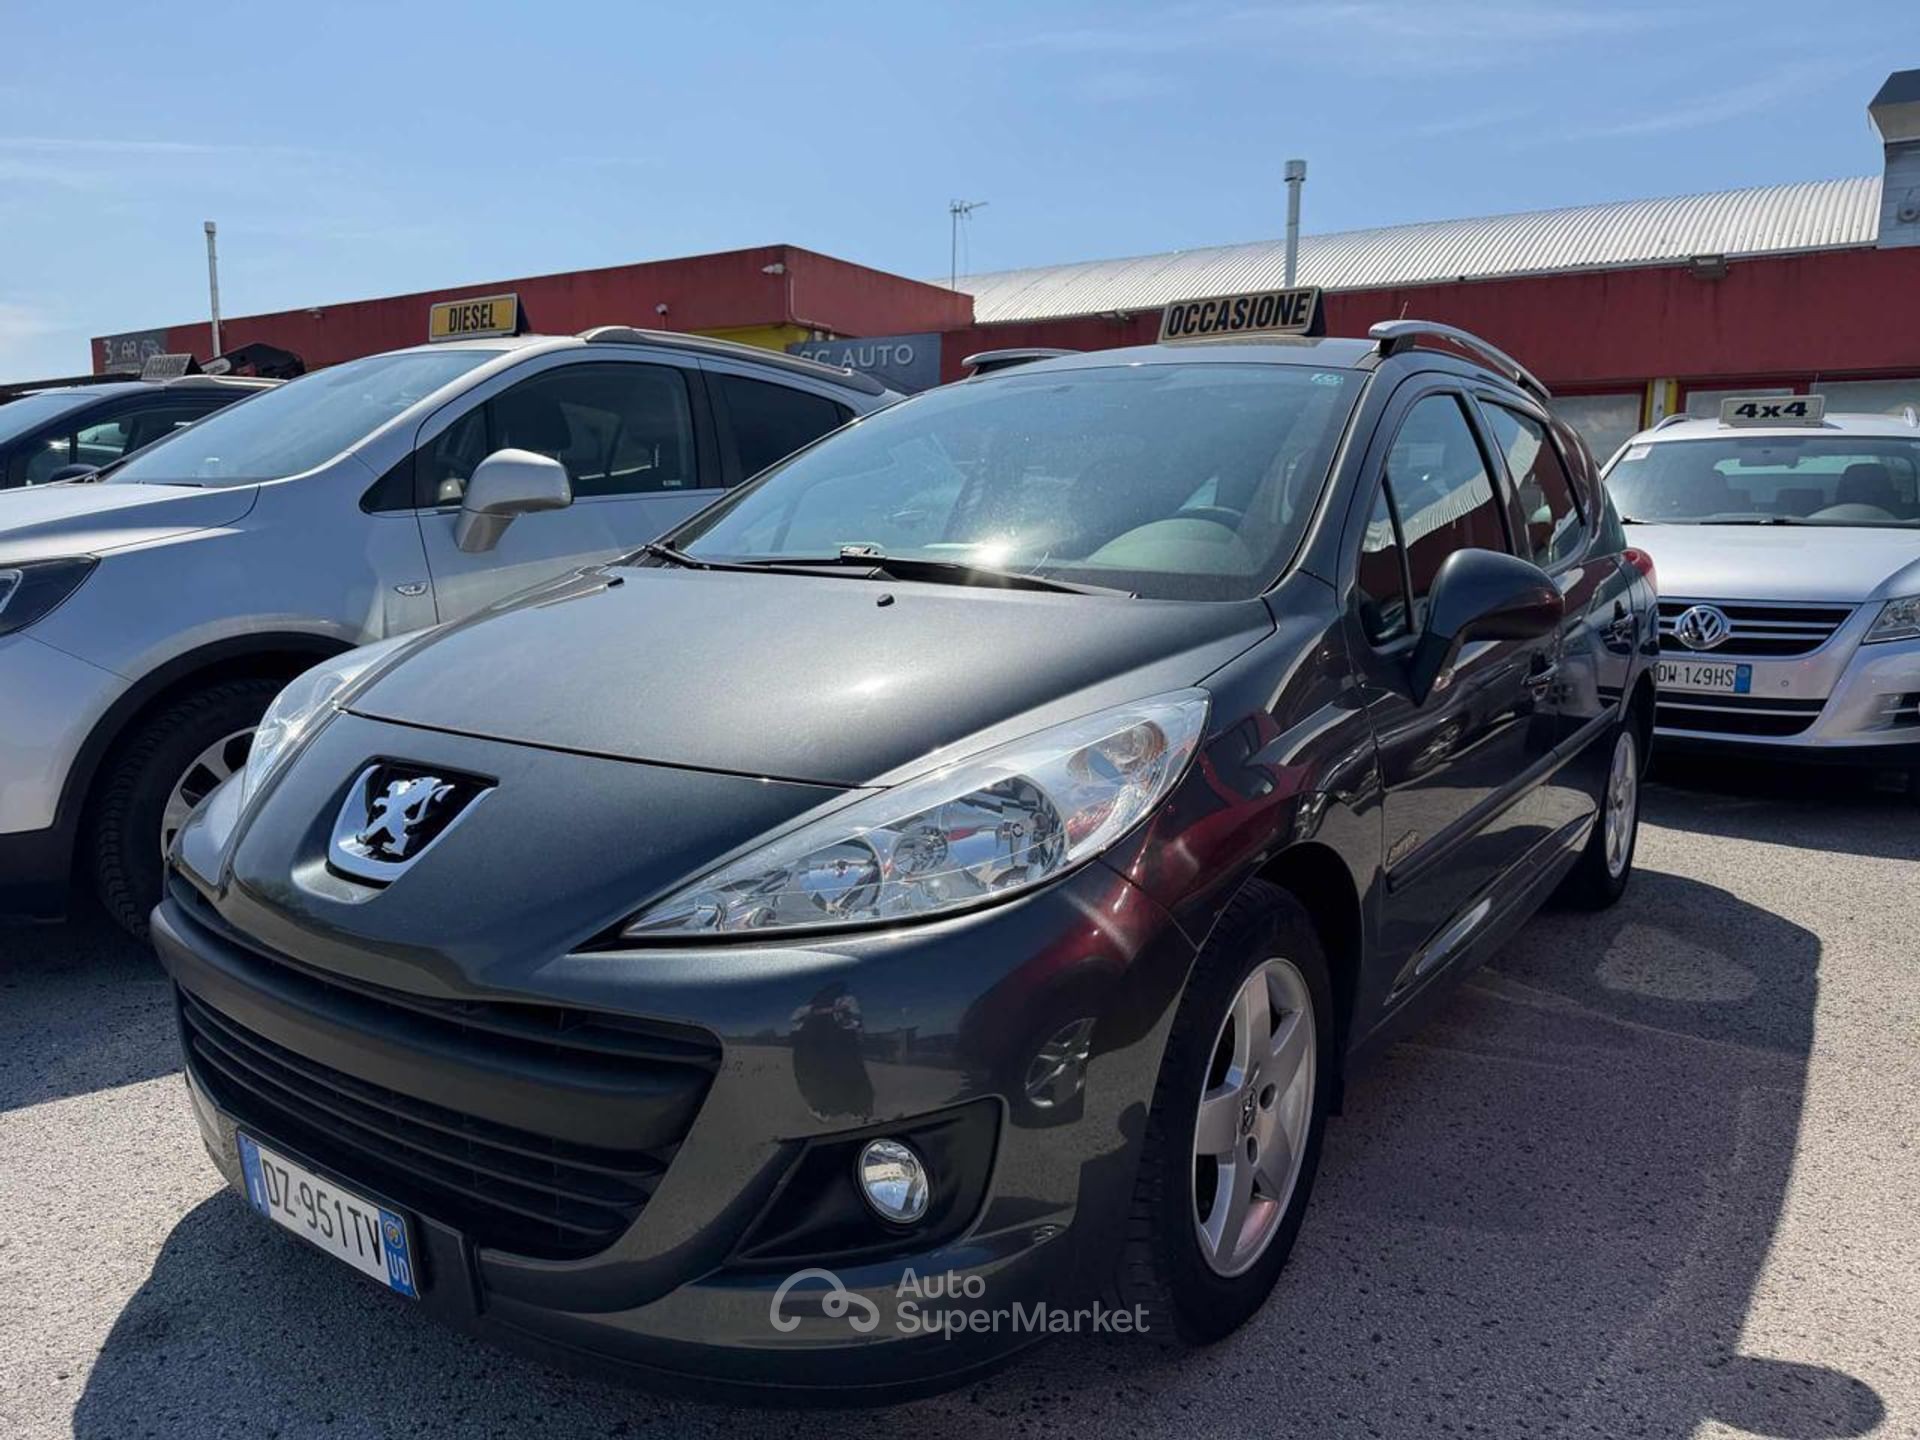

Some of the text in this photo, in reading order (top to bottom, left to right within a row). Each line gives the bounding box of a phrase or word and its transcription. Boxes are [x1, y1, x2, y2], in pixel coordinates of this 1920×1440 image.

[448, 303, 496, 332] DIESEL
[1166, 292, 1311, 336] OCCASIONE
[840, 343, 914, 368] AUTO
[1735, 401, 1809, 418] 4x4
